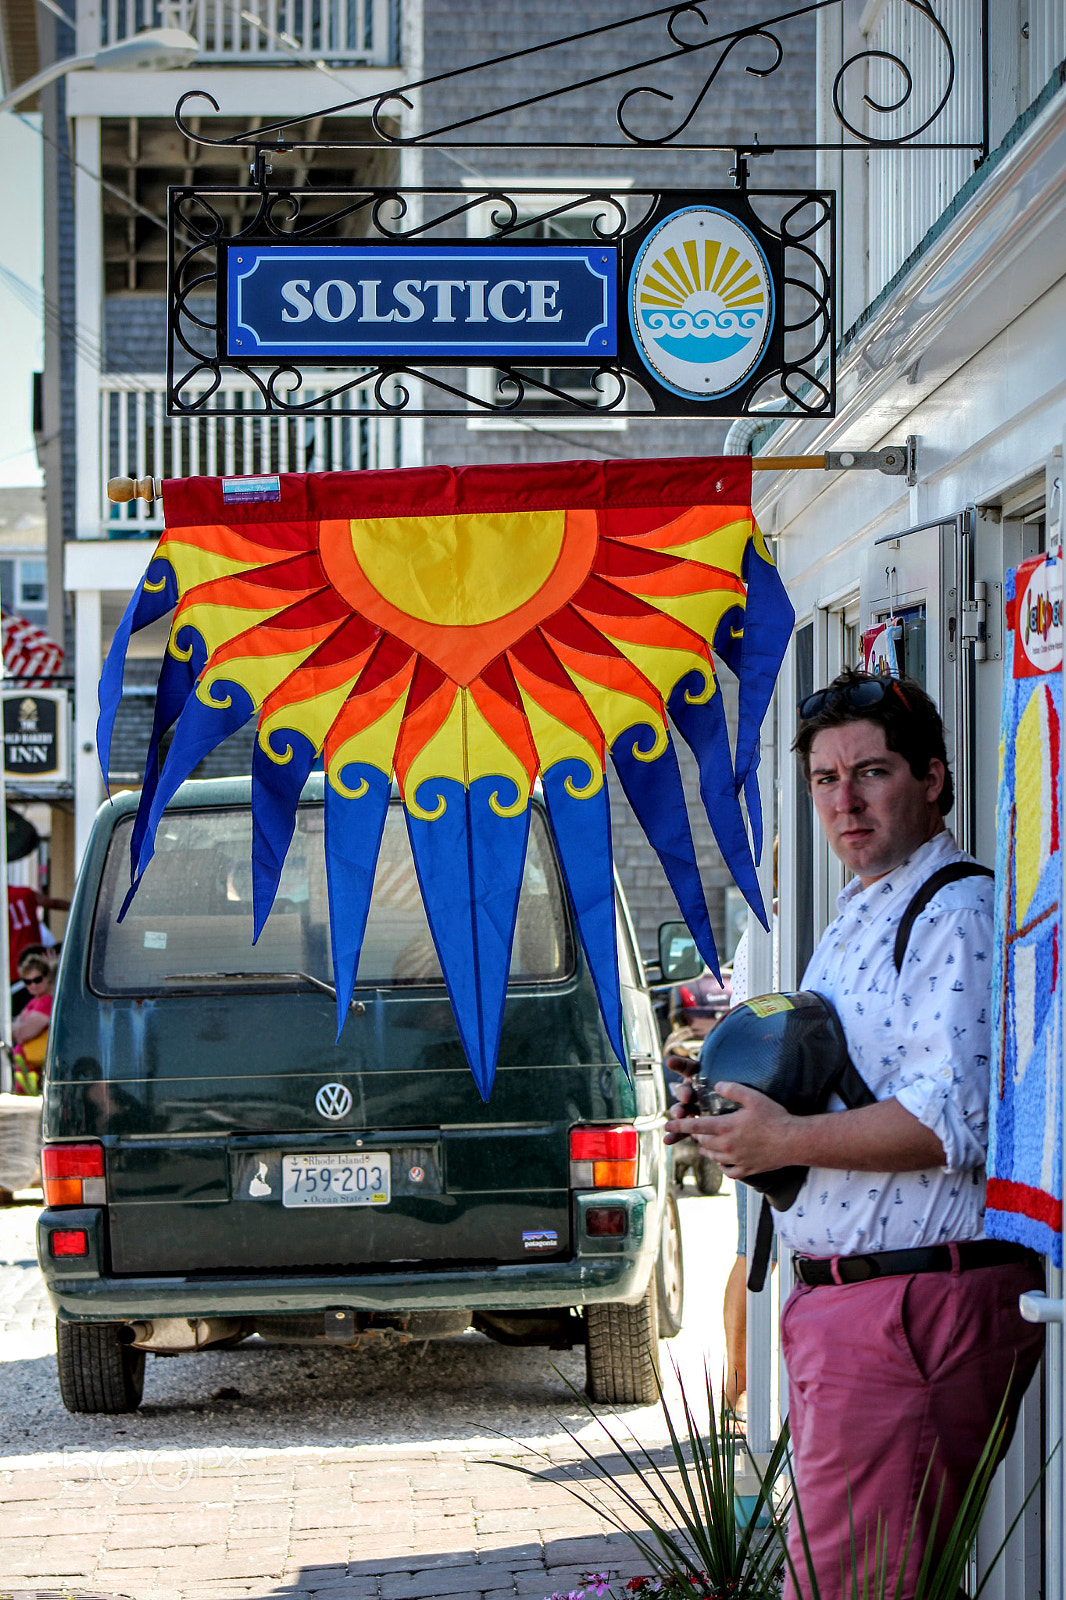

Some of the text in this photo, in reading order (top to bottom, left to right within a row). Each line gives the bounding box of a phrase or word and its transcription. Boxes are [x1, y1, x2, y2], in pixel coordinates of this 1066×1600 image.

[281, 279, 563, 323] SOLSTICE
[9, 745, 48, 763] INN
[308, 1155, 365, 1166] Rhode Island
[291, 1166, 383, 1193] 759-203
[310, 1194, 362, 1204] Ocean State
[524, 1240, 557, 1248] patagonia
